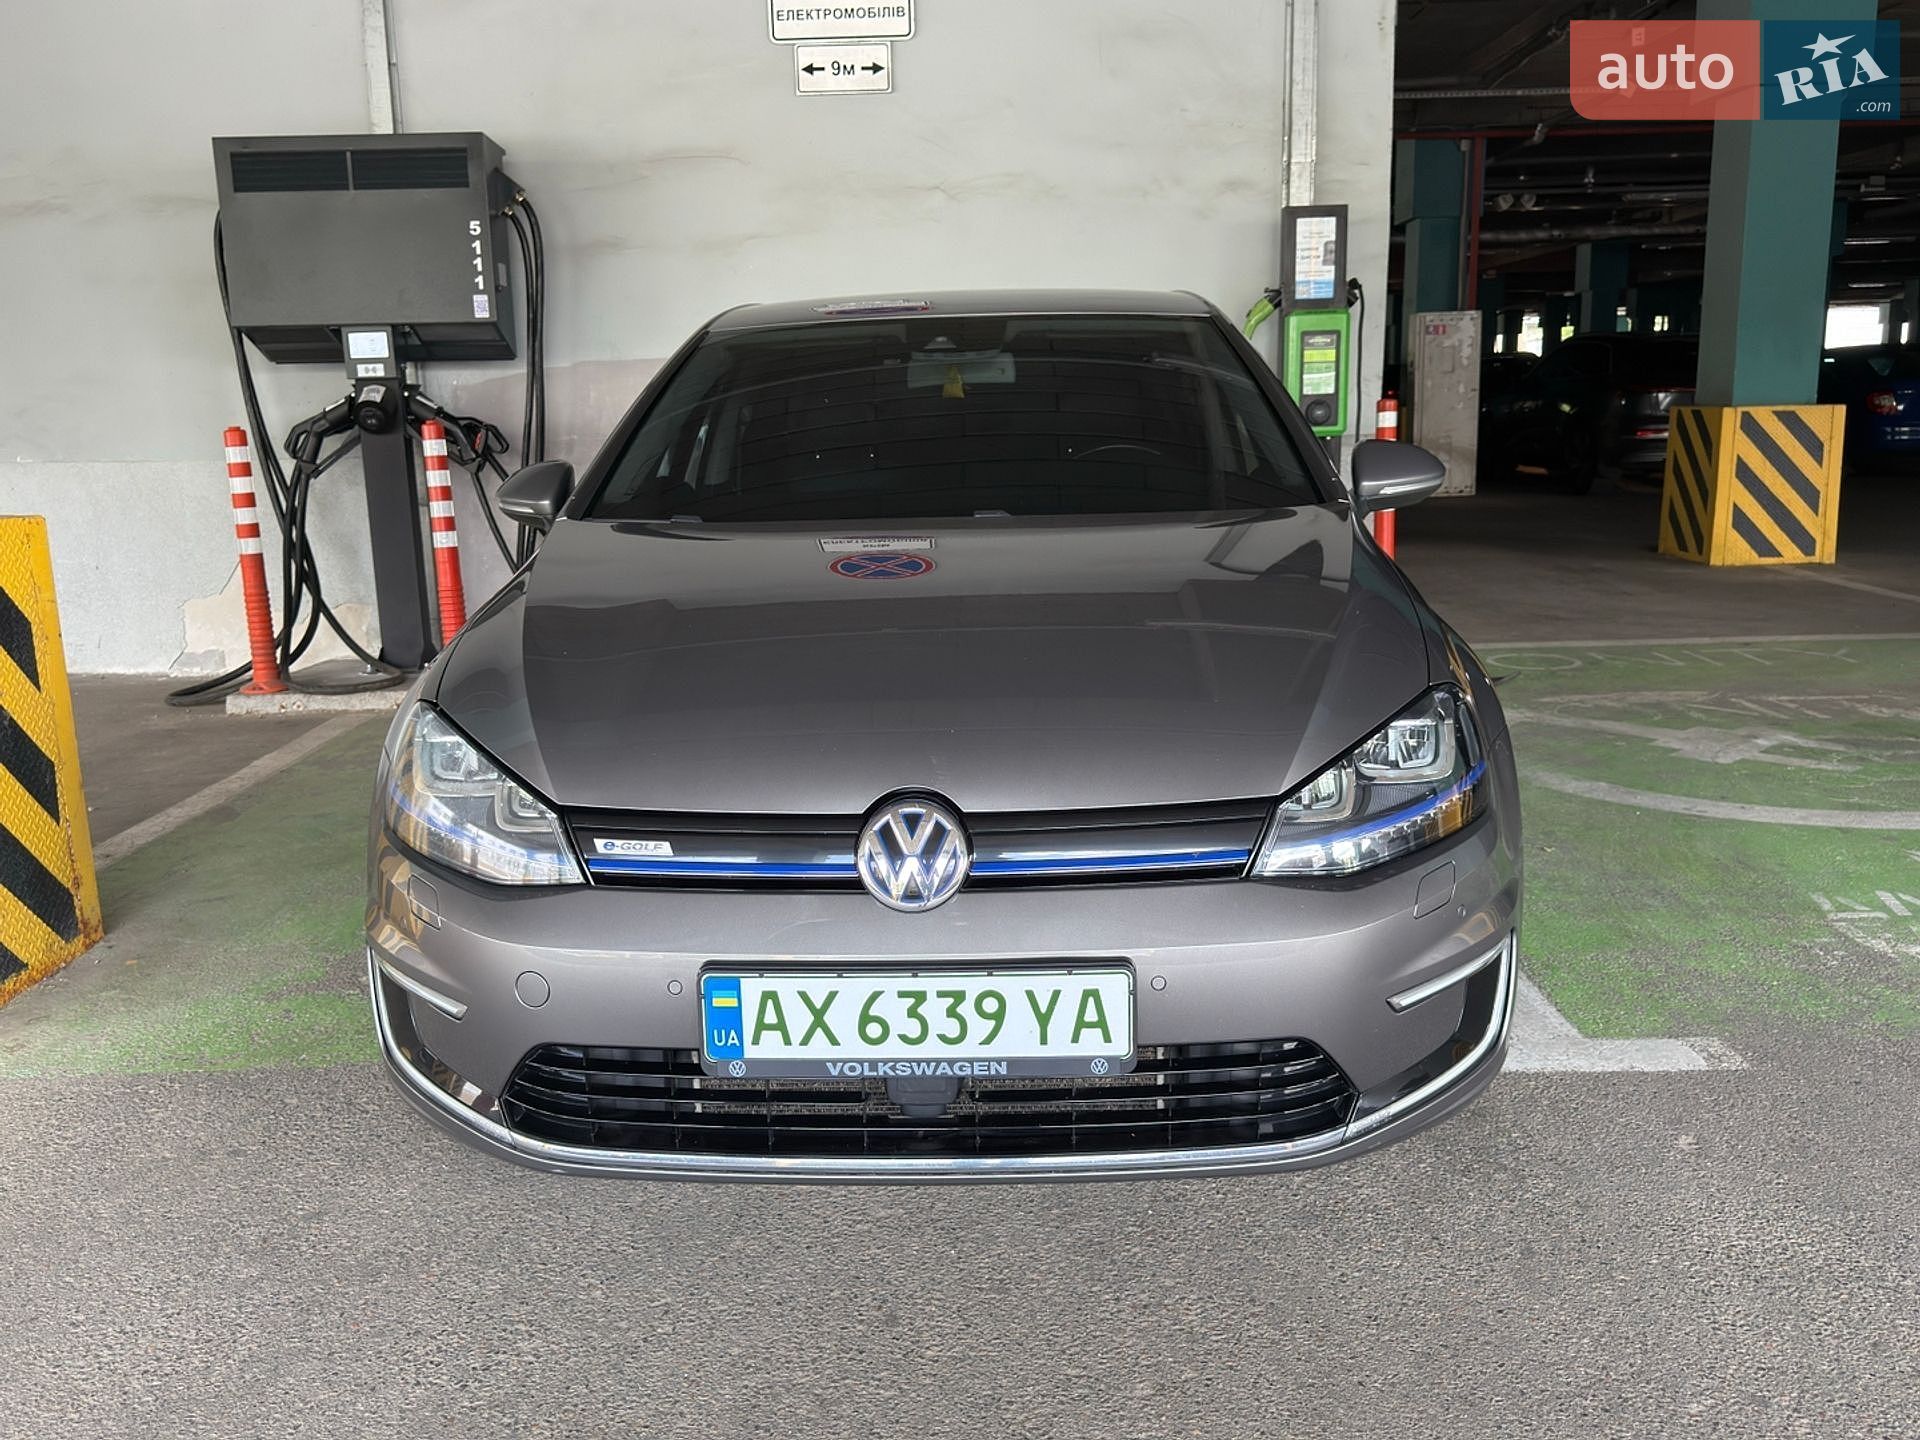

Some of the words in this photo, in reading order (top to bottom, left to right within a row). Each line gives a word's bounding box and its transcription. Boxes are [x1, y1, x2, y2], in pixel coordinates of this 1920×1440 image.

[776, 6, 906, 21] ЕЛЕКТРОМОБІЛІВ
[469, 220, 484, 290] 5111
[603, 841, 664, 851] e-GOLF
[751, 990, 841, 1046] AX
[857, 989, 1008, 1046] 6339
[1024, 988, 1113, 1045] YA
[713, 1030, 740, 1048] UA
[826, 1061, 1008, 1077] VOLKSWAGEN
